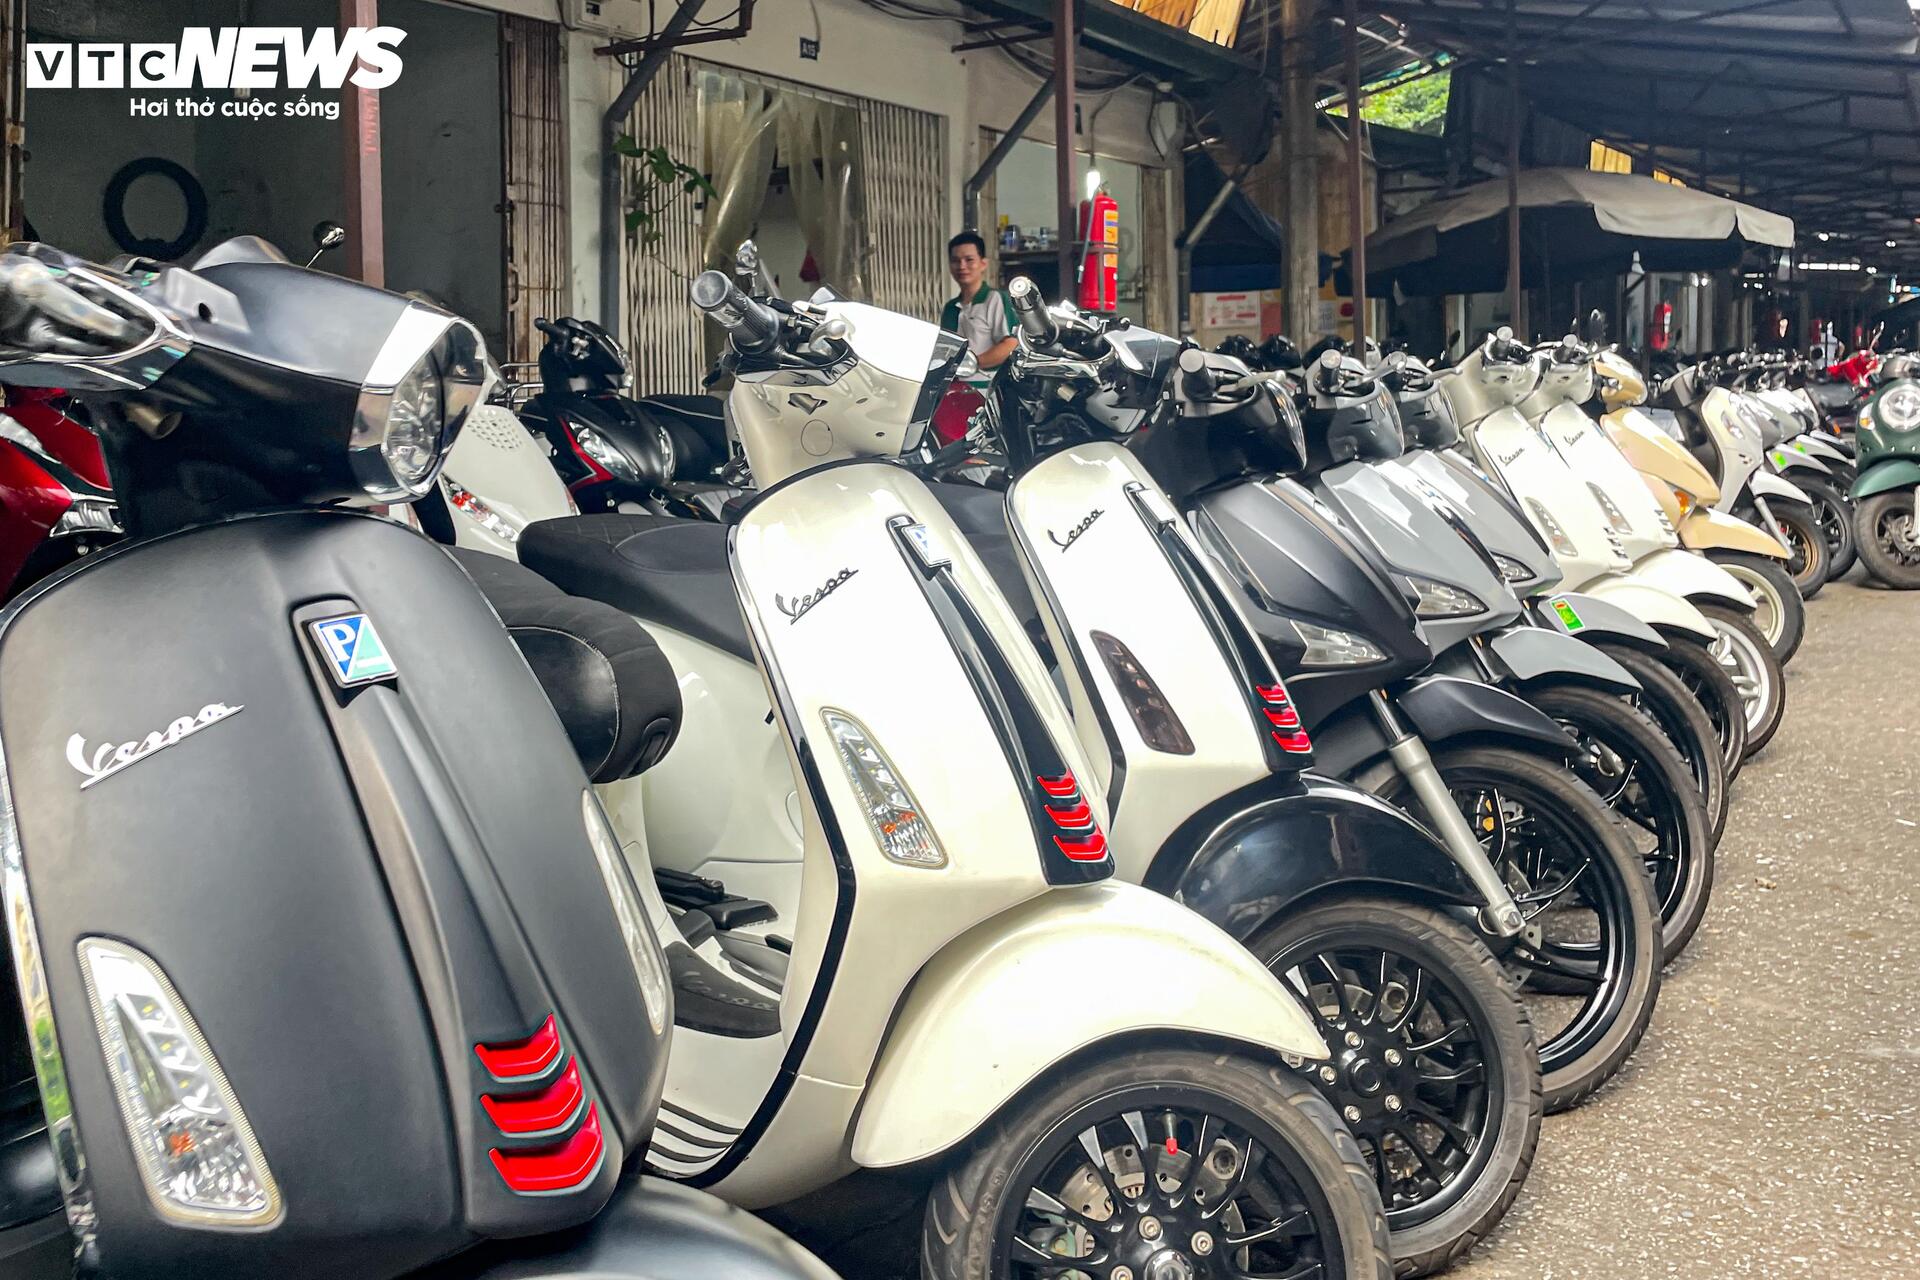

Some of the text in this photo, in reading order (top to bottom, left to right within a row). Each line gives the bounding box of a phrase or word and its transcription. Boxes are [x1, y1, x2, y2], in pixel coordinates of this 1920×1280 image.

[1047, 508, 1105, 553] Vespa
[775, 567, 859, 625] Vespa
[66, 702, 245, 791] Vespa
